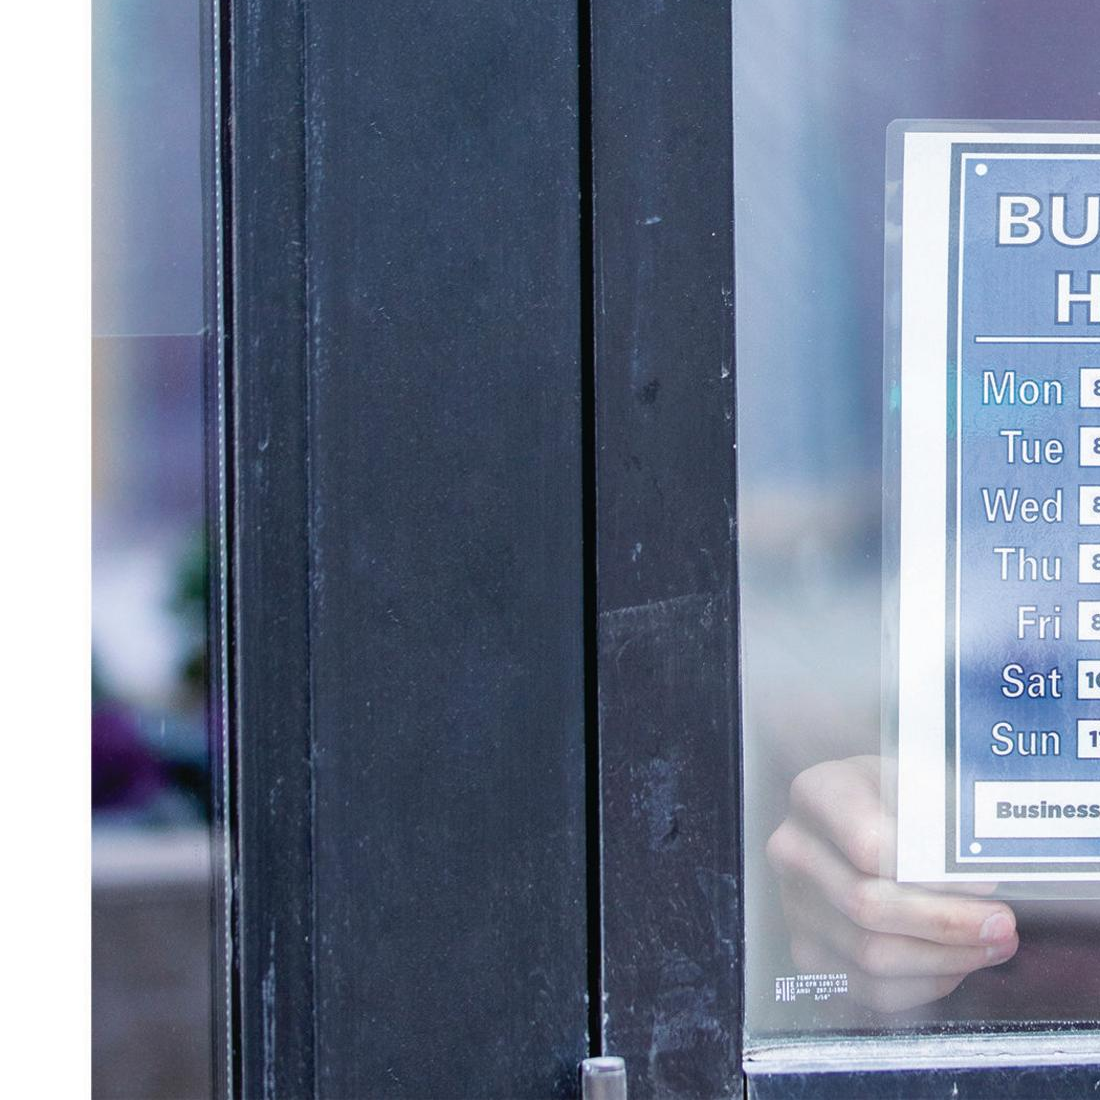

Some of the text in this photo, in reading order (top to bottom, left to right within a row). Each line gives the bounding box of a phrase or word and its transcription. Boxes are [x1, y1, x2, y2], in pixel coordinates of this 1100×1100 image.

[982, 370, 1063, 406] Mon
[999, 429, 1064, 465] Tue
[981, 488, 1063, 523] Wed
[992, 546, 1062, 582] Thu
[1017, 605, 1061, 640] Fri
[1001, 663, 1062, 699] Sat
[990, 721, 1060, 757] Sun
[996, 800, 1100, 819] Business
